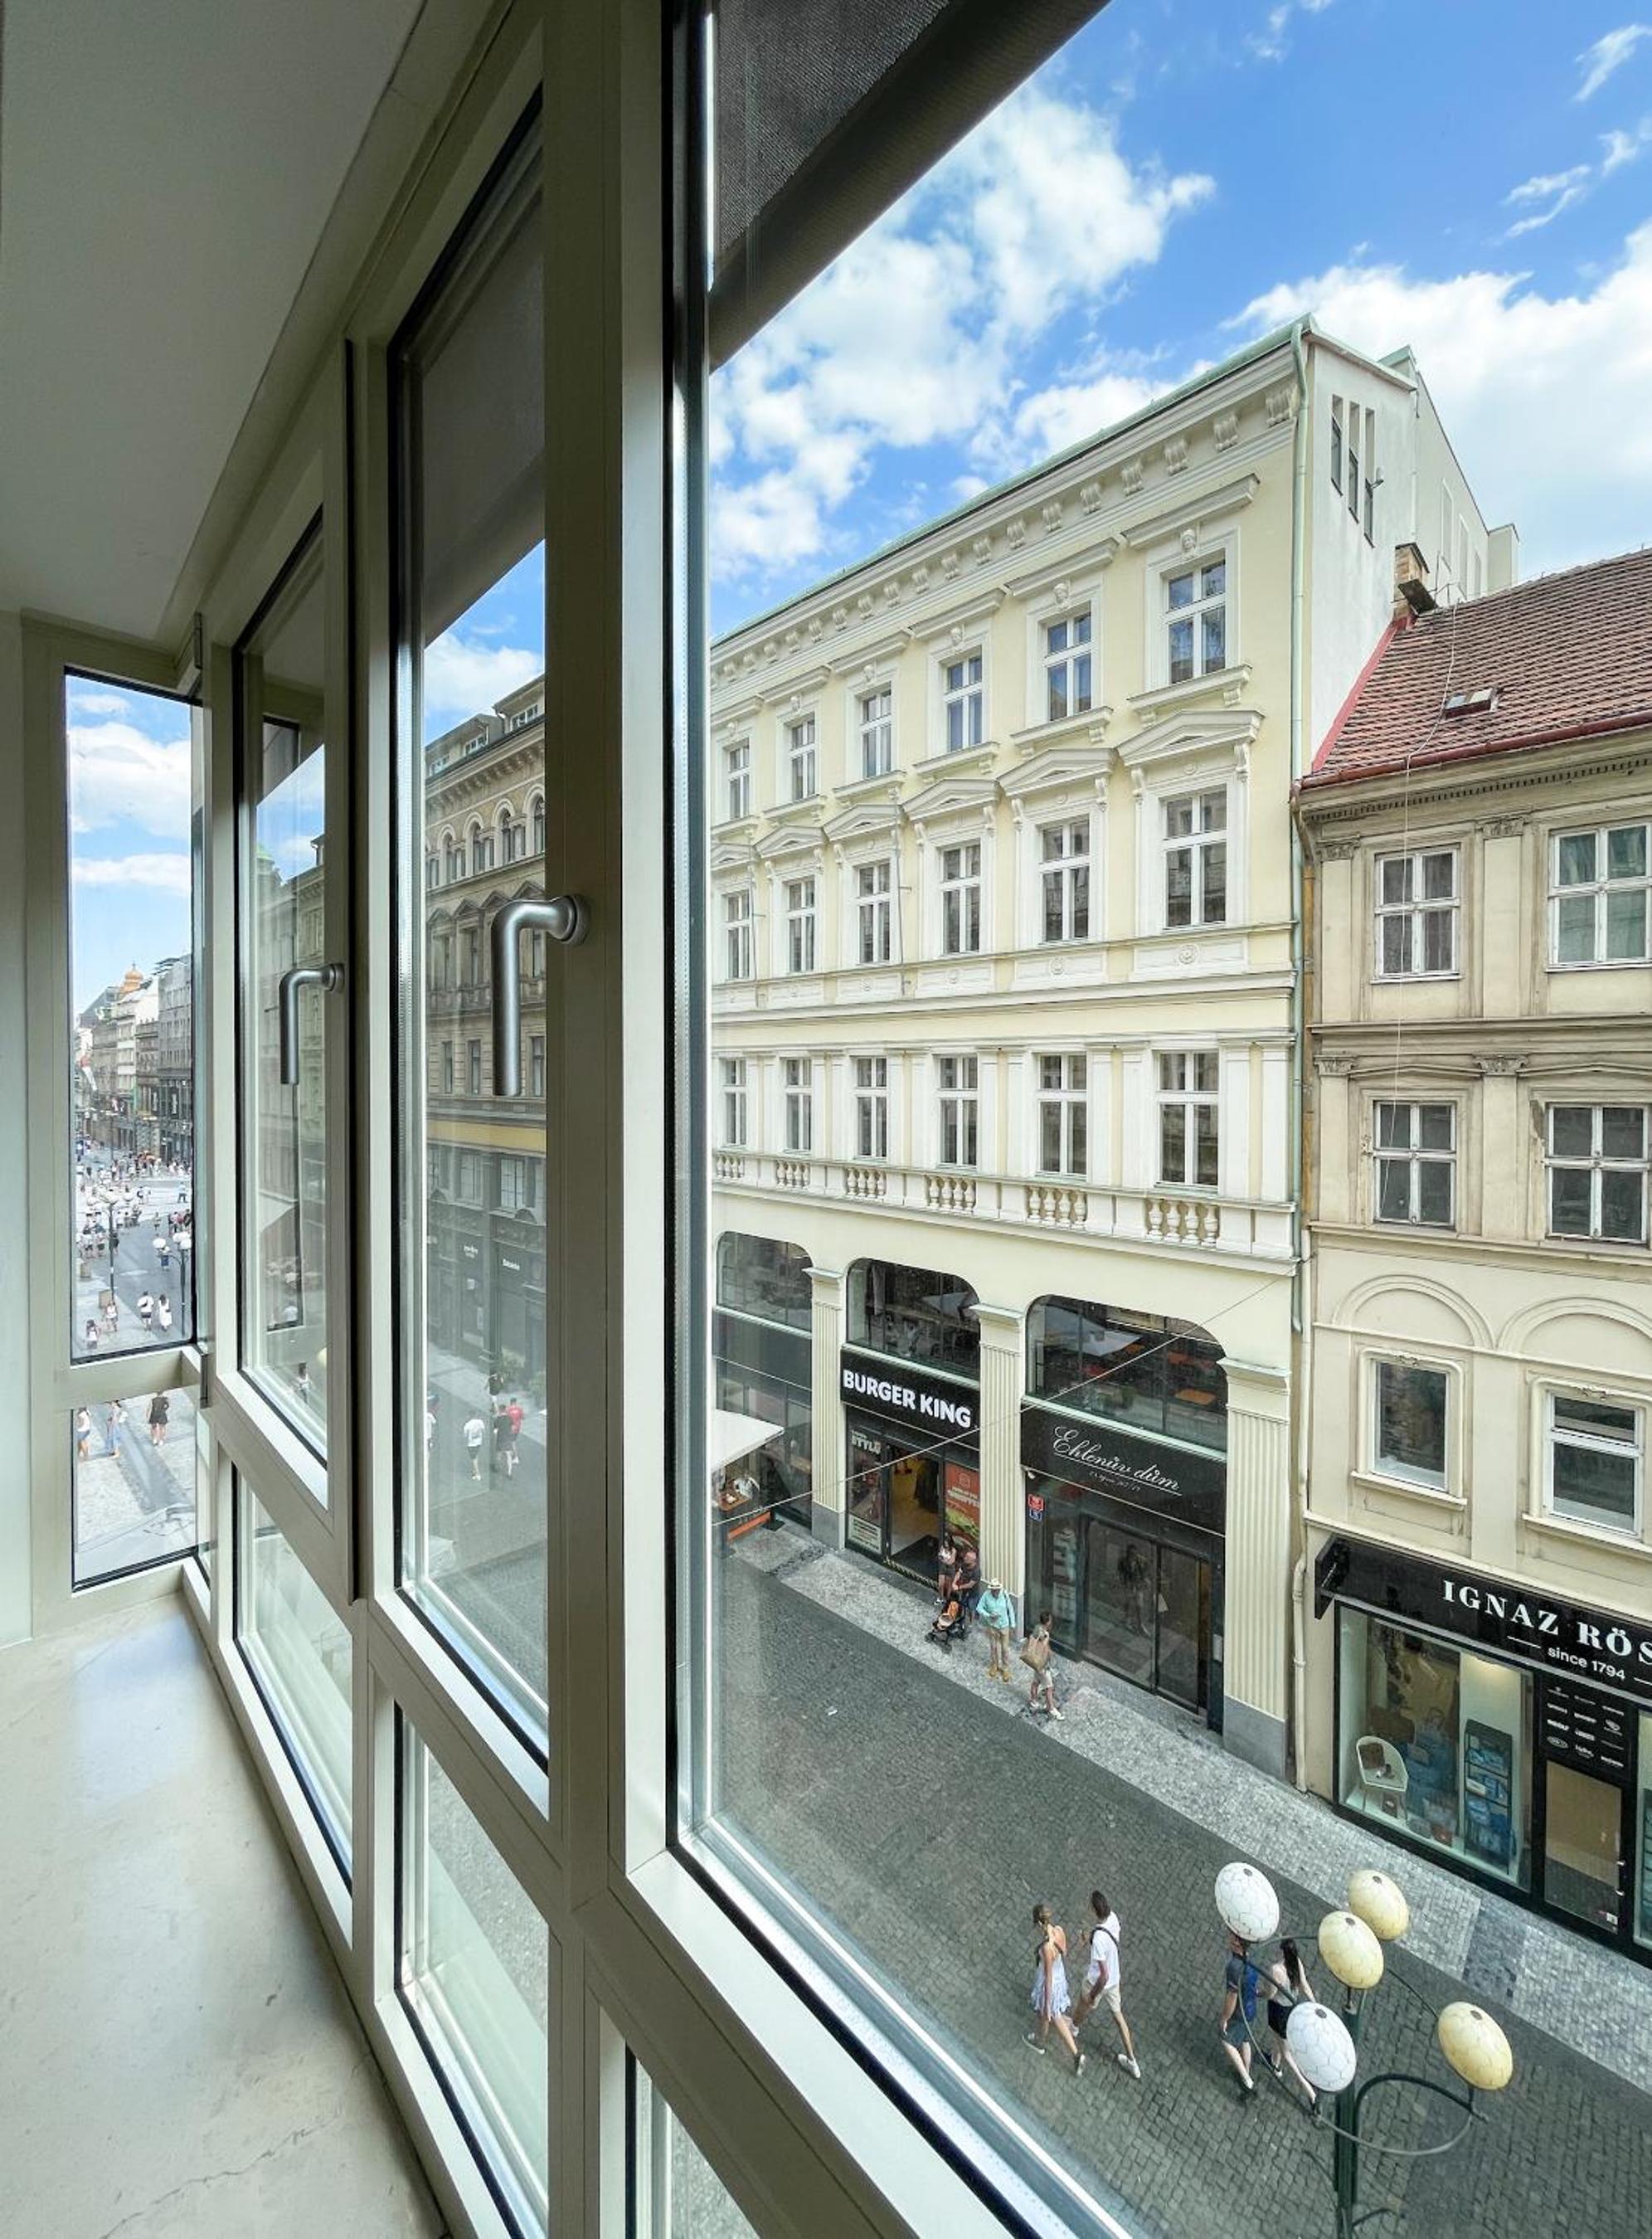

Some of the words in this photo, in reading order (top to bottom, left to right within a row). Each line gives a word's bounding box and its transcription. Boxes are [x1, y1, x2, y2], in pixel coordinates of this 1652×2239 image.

[843, 1369, 916, 1410] BURGER
[920, 1394, 971, 1429] KING
[1133, 1463, 1180, 1492] dům
[1442, 1579, 1559, 1636] IGNAZ
[1548, 1647, 1587, 1667] since
[1591, 1660, 1626, 1681] 1794
